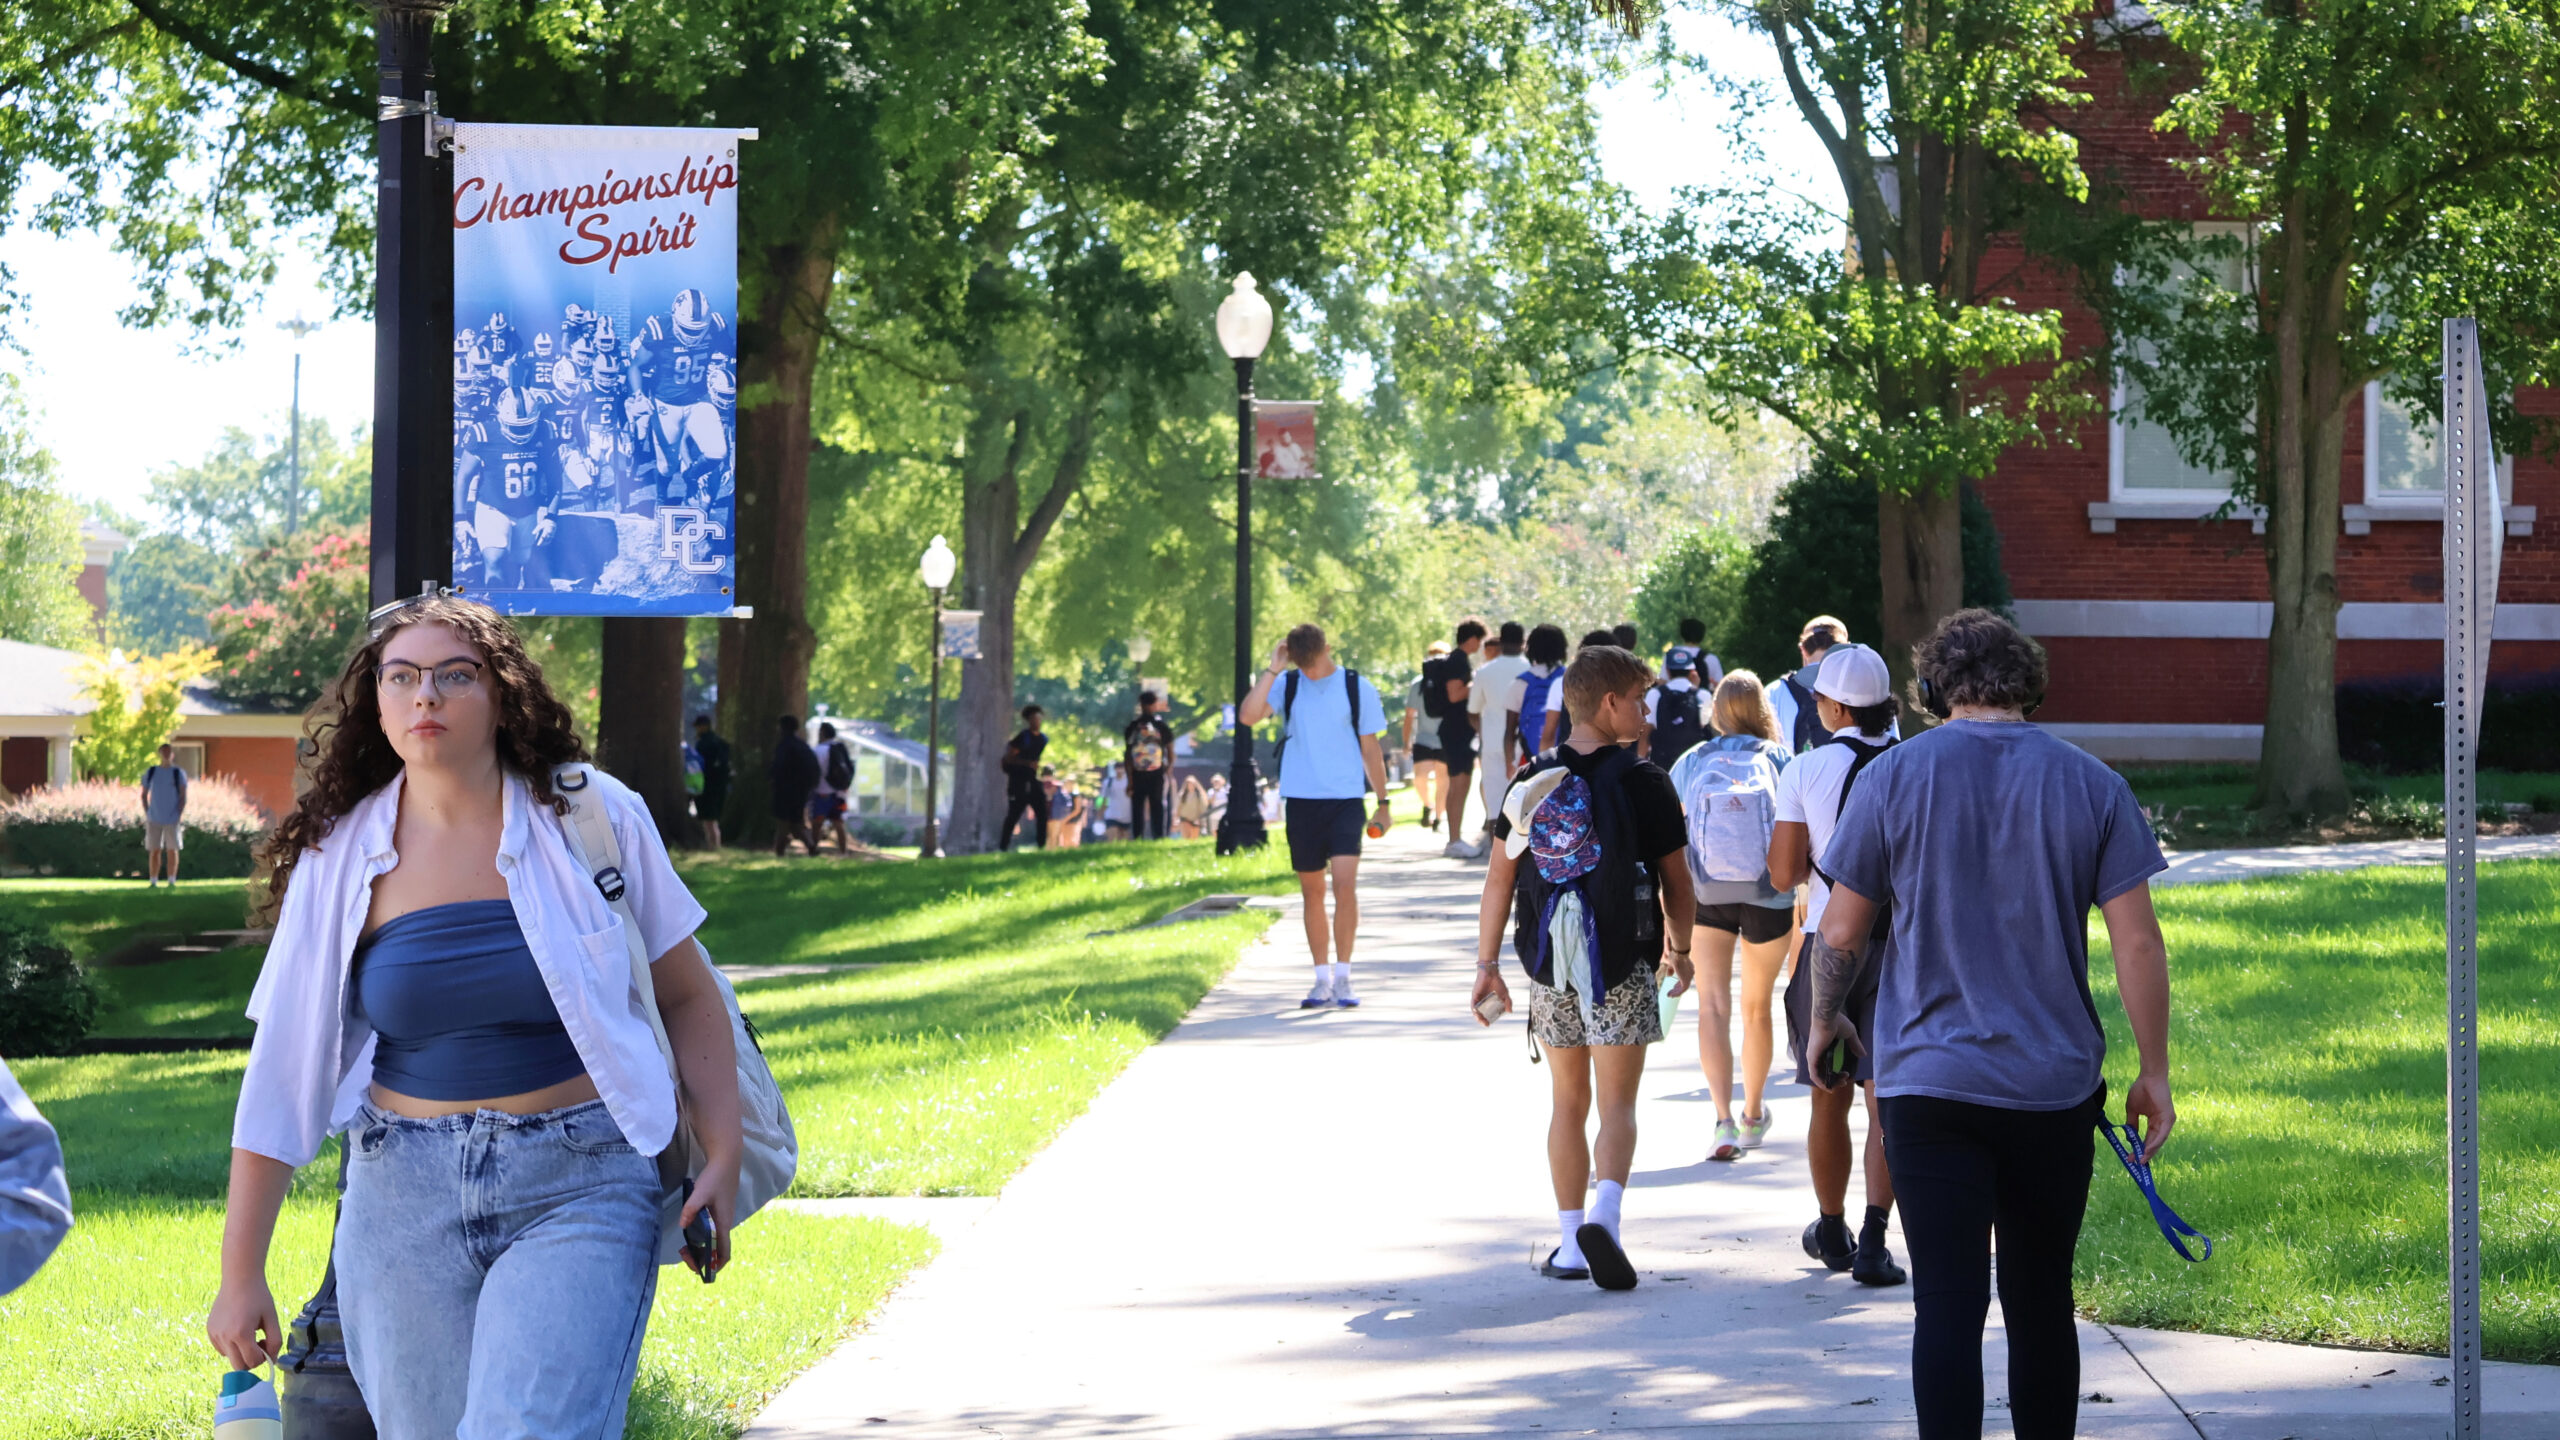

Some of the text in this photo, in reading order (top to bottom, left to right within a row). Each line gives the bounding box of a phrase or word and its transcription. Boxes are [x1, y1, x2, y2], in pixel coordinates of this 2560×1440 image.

[454, 155, 738, 229] Championship
[559, 212, 697, 275] Spirit
[673, 353, 708, 385] 95
[504, 461, 538, 499] 66
[658, 506, 726, 574] PC
